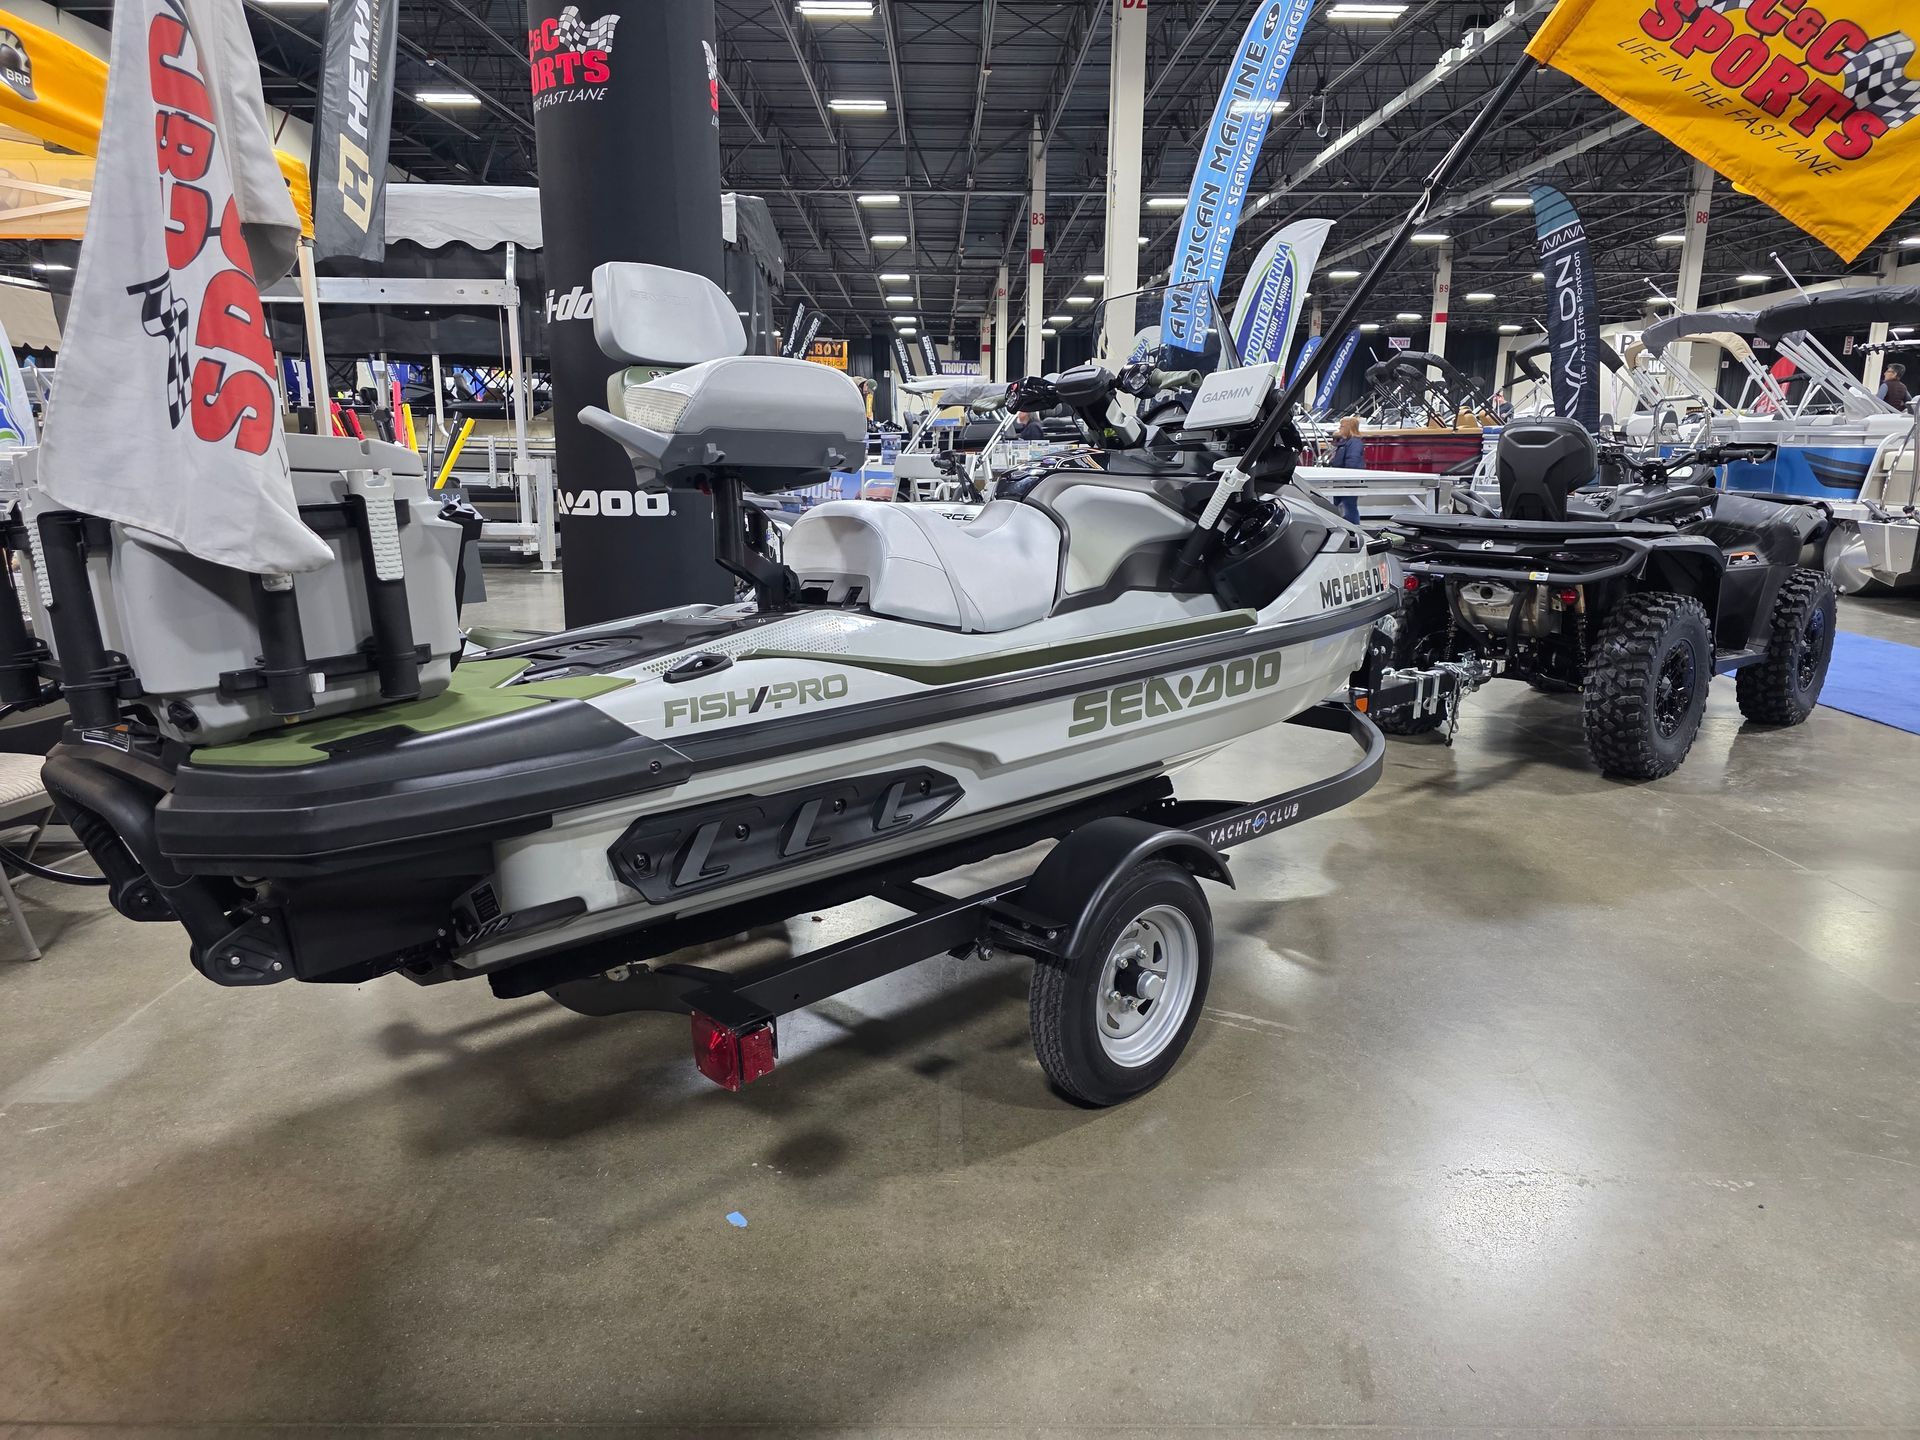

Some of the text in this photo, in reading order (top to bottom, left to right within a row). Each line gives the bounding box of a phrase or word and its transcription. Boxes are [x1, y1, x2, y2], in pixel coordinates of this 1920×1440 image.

[1745, 0, 1869, 76] C&C
[6, 68, 31, 87] BRP
[529, 49, 611, 97] ORTS
[1639, 0, 1890, 160] SPORTS
[543, 90, 568, 108] FAST
[568, 87, 609, 102] LANE
[1617, 37, 1842, 177] LIFE IN THE FAST LANE
[1211, 225, 1231, 270] LIFTS
[1228, 112, 1268, 207] SEAWALLS
[1265, 0, 1309, 92] STORAGE
[1168, 41, 1268, 340] AMERICAN MARINE
[1032, 212, 1045, 225] B3
[1696, 211, 1708, 224] B8
[1439, 284, 1449, 293] B9
[1264, 315, 1279, 350] DETROIT
[1277, 276, 1291, 311] LANSING
[1573, 251, 1588, 386] The Art of the Pontoon
[941, 362, 966, 374] TROUT
[1323, 333, 1356, 396] STINGRAY
[1202, 386, 1253, 404] GARMIN
[939, 512, 975, 521] RCE
[1320, 577, 1342, 609] MC
[1210, 803, 1299, 845] YACHT CLUB
